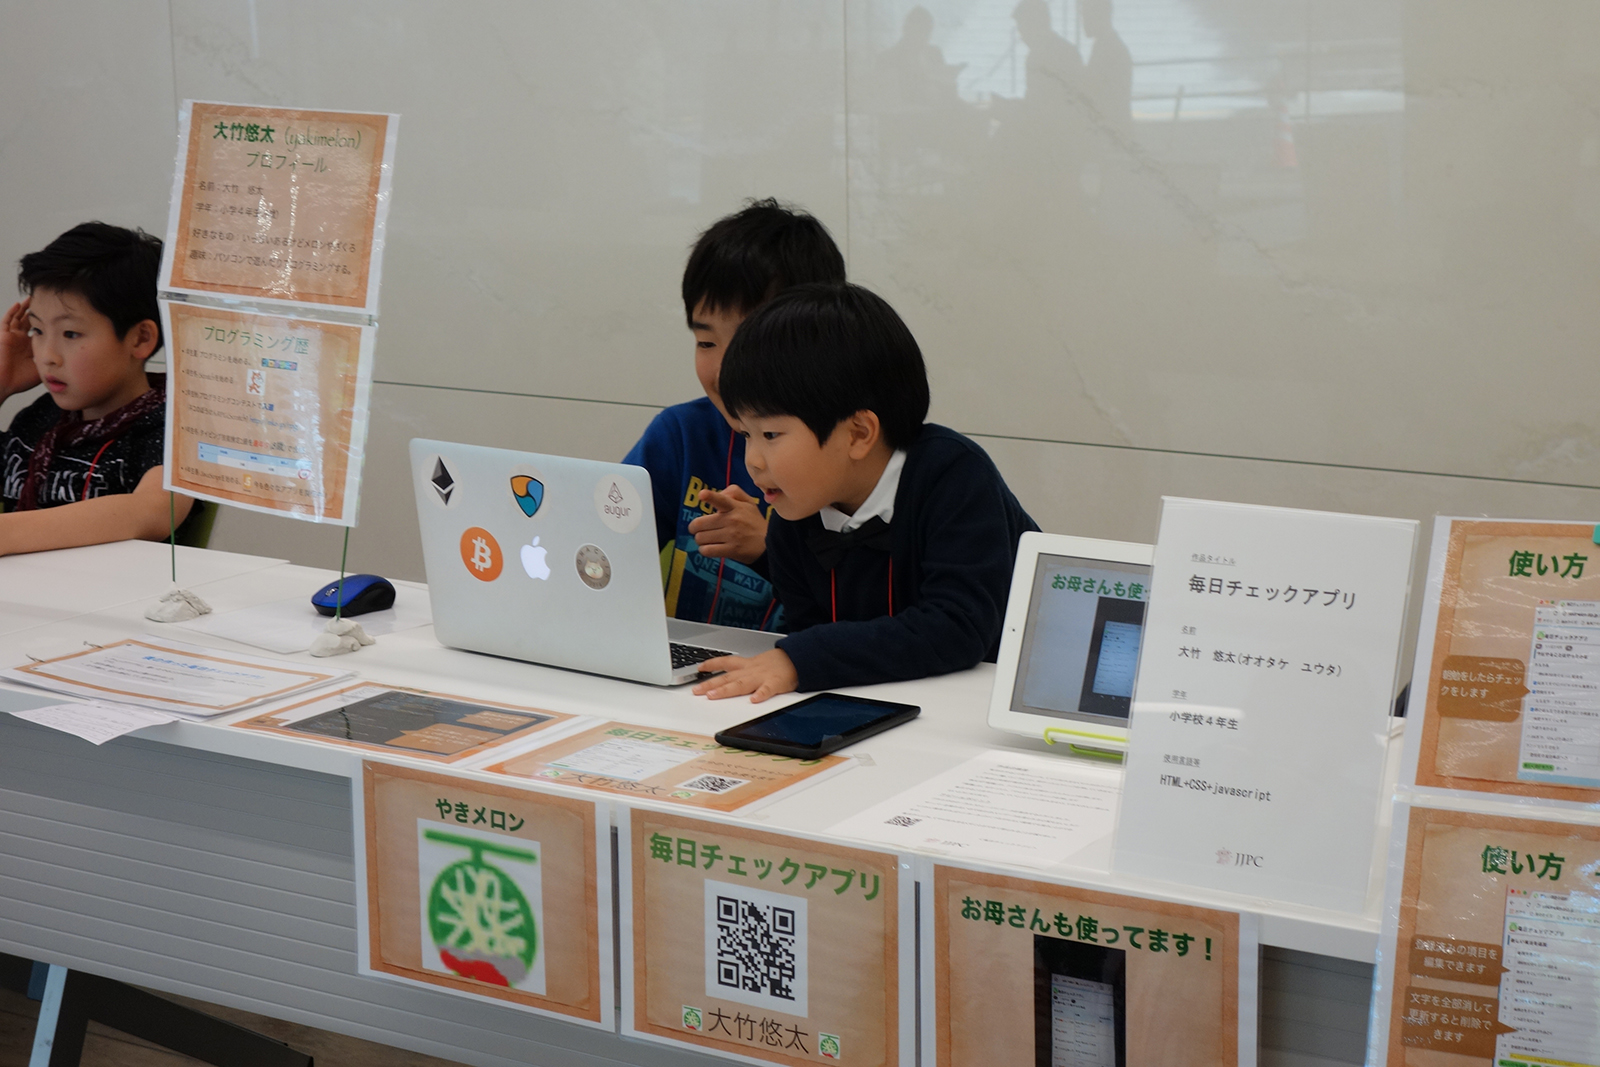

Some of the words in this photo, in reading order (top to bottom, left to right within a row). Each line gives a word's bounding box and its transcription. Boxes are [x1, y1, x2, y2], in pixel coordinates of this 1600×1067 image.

[213, 121, 275, 144] 大竹悠太
[246, 152, 328, 173] プロフィール
[204, 326, 311, 355] プログラミング歴
[604, 504, 632, 519] augur
[694, 553, 720, 575] ONE
[1508, 550, 1588, 579] 使い方
[733, 573, 761, 591] WAY
[1051, 574, 1150, 600] お母さんも使
[1188, 574, 1356, 610] 毎日チェックアプリ
[1178, 646, 1201, 660] 大竹
[1440, 685, 1490, 699] クをします
[560, 772, 667, 797] 大竹悠太
[1160, 774, 1272, 803] HTML+CSS+javascript
[435, 798, 525, 832] やきメロン
[650, 832, 881, 901] 毎日チェックアプリ
[1234, 852, 1264, 868] JJPC
[1481, 845, 1566, 881] 使い方
[960, 896, 1213, 961] お母さんも使ってます！
[1423, 956, 1487, 975] 編集できます
[1409, 993, 1493, 1014] 文字を全部消して
[708, 1007, 809, 1054] 大竹悠太
[1433, 1028, 1465, 1043] きます
